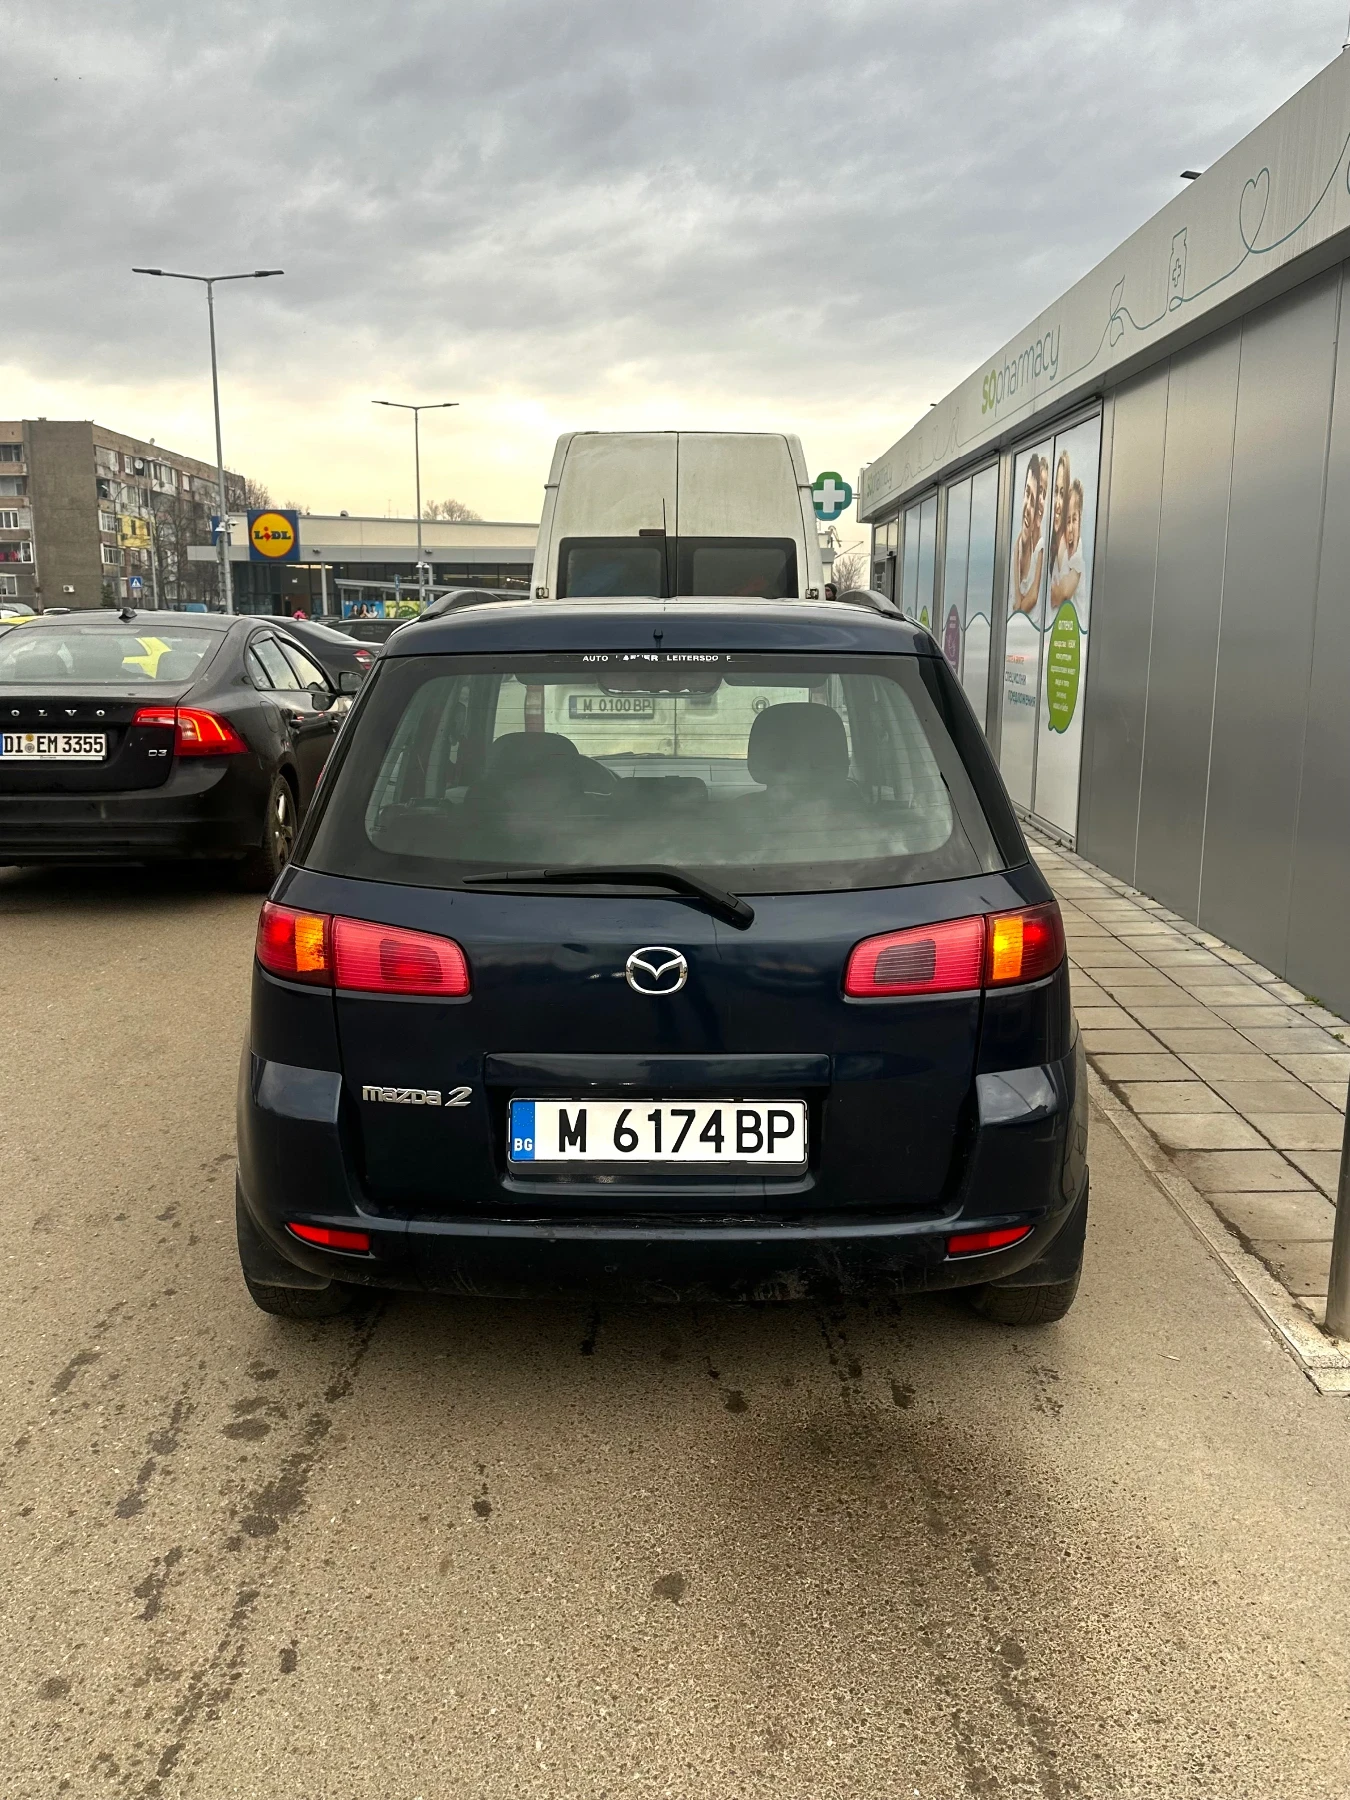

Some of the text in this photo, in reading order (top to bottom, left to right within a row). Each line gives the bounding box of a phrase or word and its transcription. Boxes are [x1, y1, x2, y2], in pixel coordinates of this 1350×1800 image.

[981, 324, 1061, 418] sopharmacy
[583, 699, 593, 712] M
[4, 735, 104, 754] DI EM 3355
[148, 749, 168, 757] D3
[445, 1086, 473, 1107] 2
[558, 1108, 587, 1154] M
[513, 1137, 533, 1152] BG
